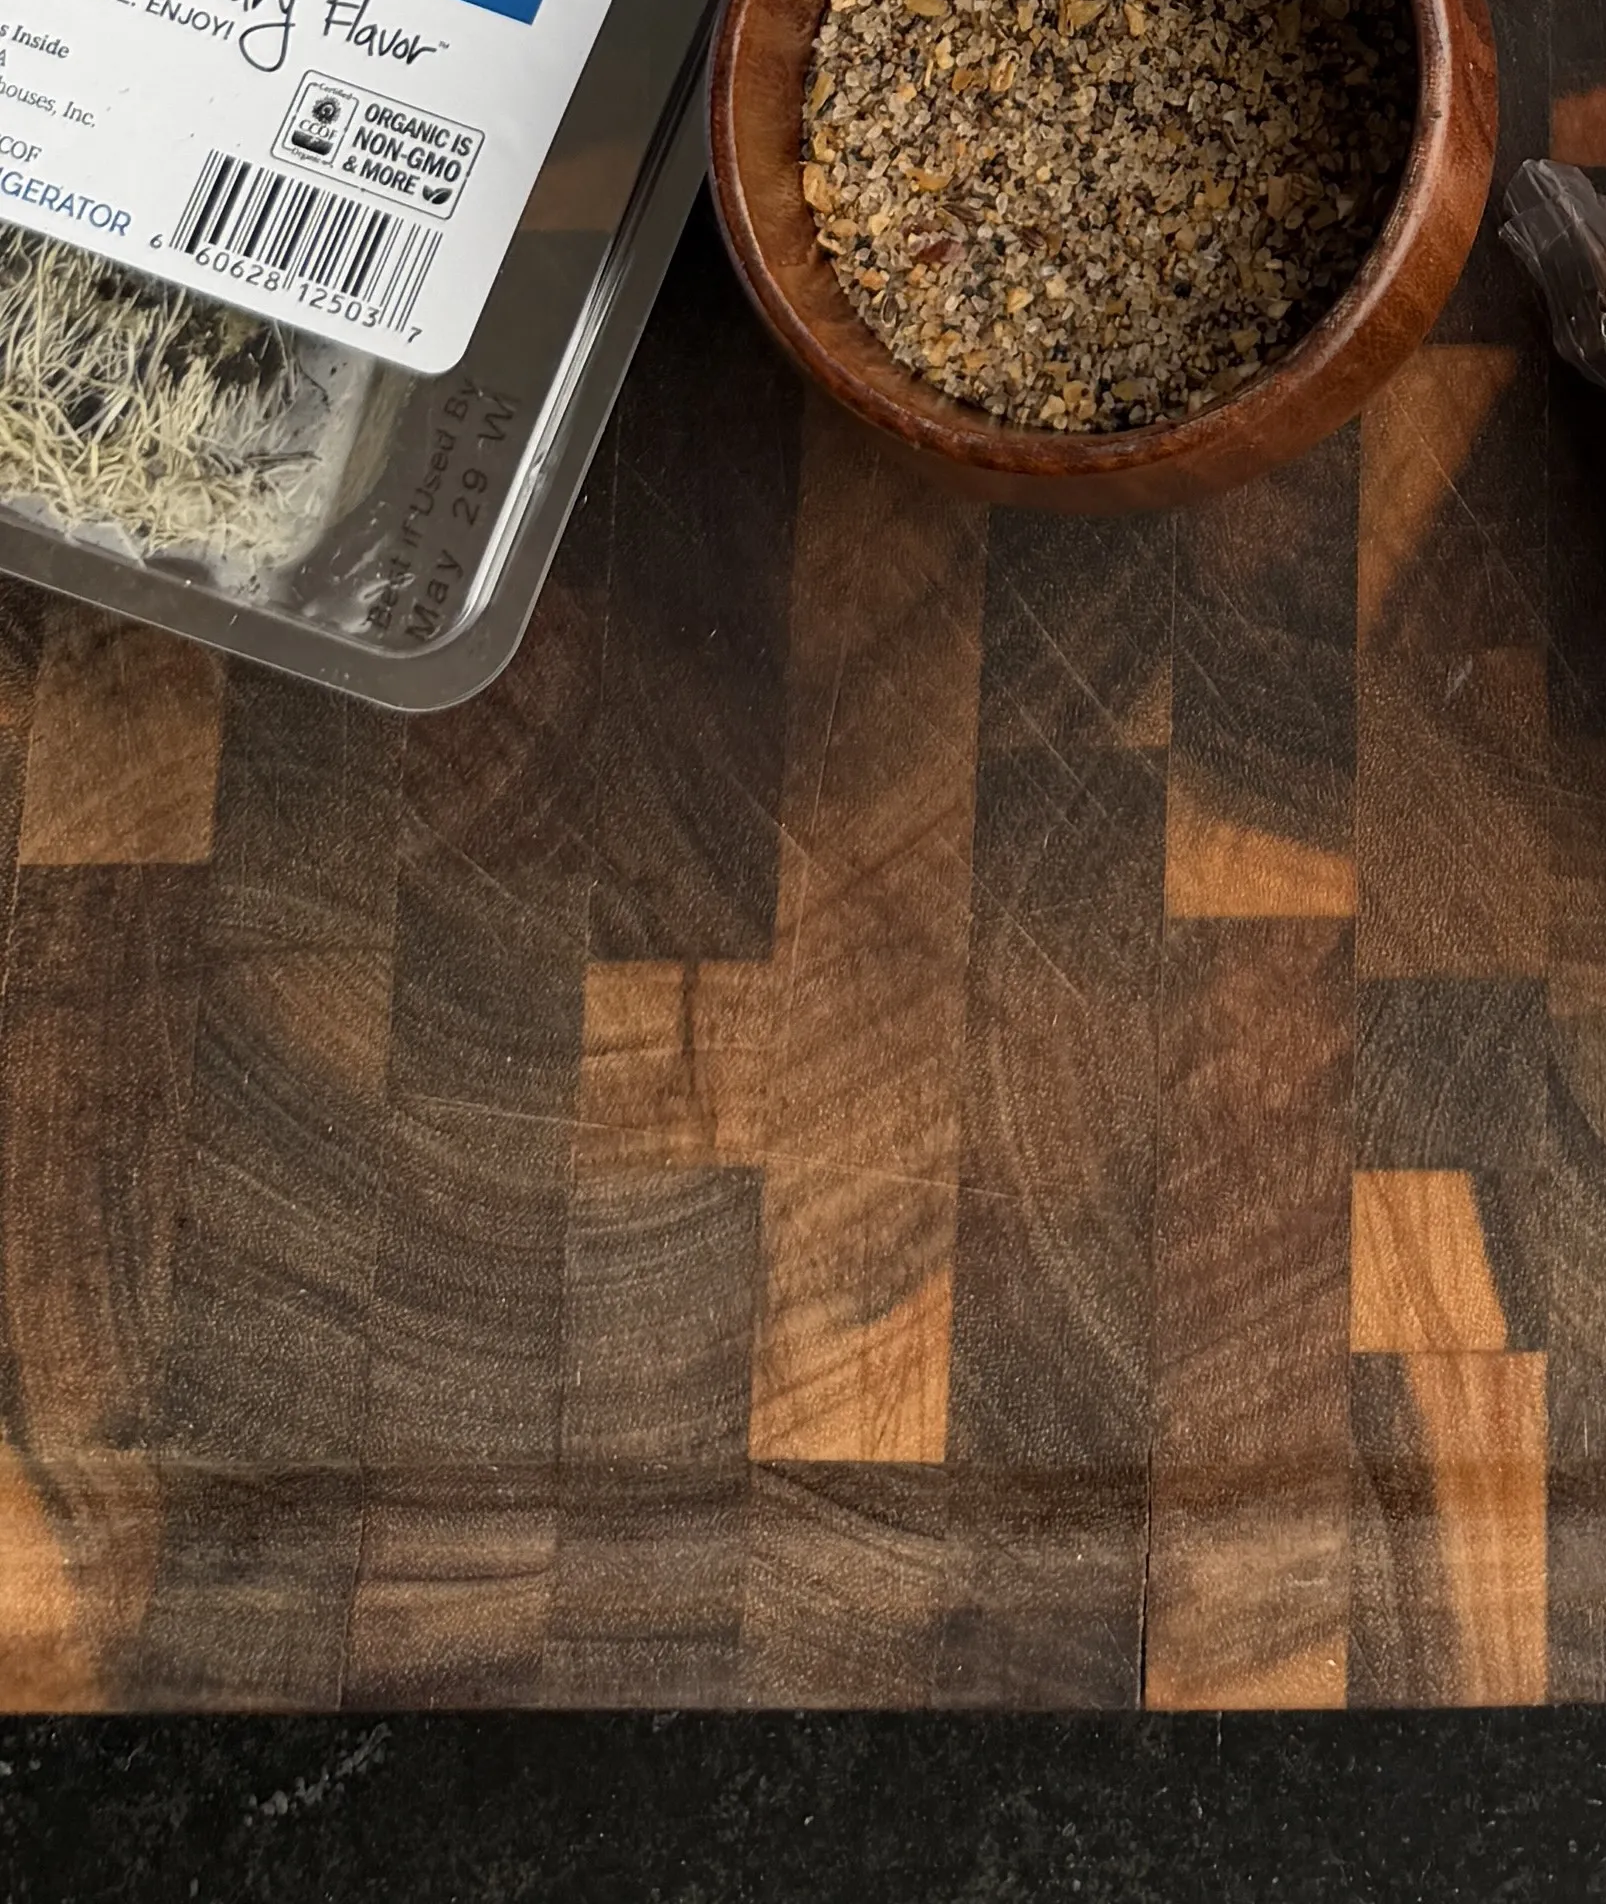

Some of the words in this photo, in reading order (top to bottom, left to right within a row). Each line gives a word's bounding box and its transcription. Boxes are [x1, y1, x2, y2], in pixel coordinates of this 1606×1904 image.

[12, 25, 71, 59] Inside
[62, 100, 97, 129] Inc.
[364, 103, 450, 149] ORGANIC
[450, 133, 473, 157] IS
[341, 155, 357, 174] &
[358, 158, 420, 195] MORE
[351, 126, 461, 182] NON-GMO
[149, 233, 162, 249] 6
[195, 247, 280, 291] 60628
[298, 282, 380, 328] 12503
[407, 326, 422, 343] 7
[406, 548, 464, 642] May
[452, 468, 488, 526] 29
